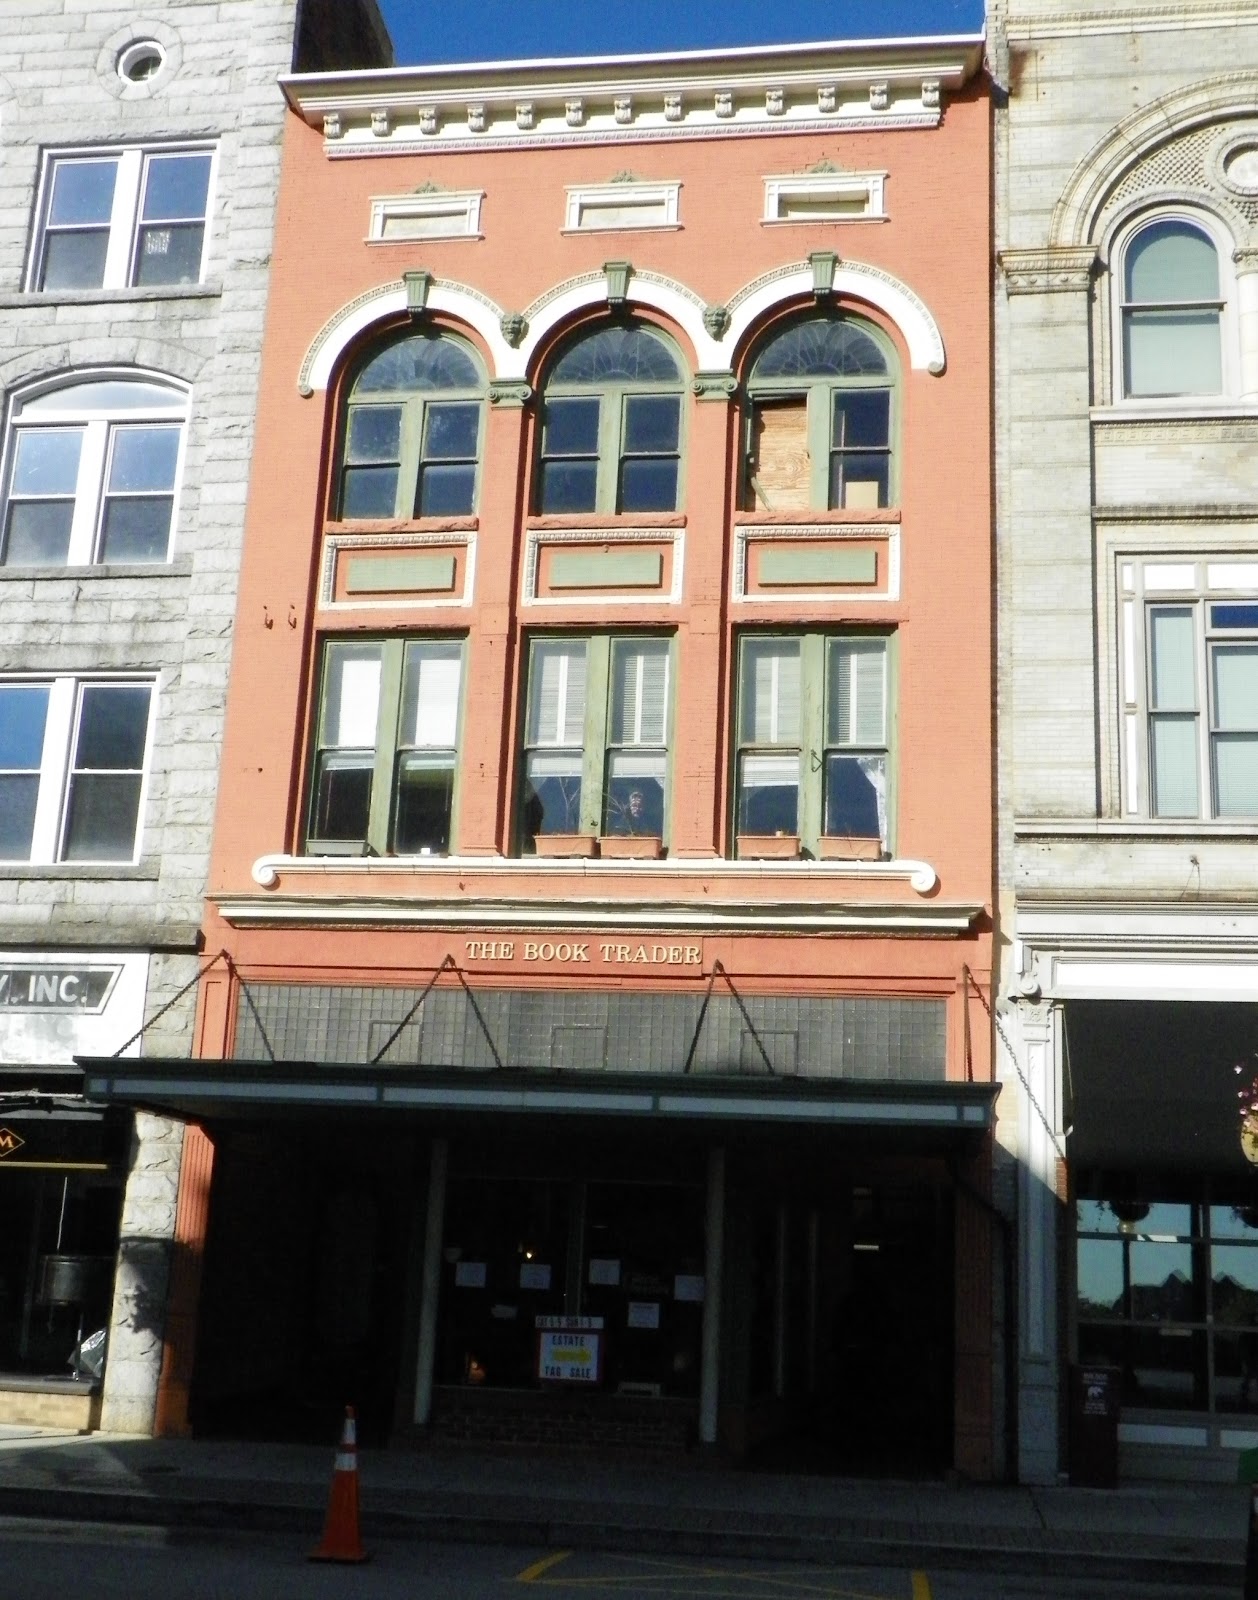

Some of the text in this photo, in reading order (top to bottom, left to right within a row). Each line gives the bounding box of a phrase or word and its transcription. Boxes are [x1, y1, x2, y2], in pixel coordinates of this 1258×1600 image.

[465, 941, 702, 965] THE BOOK TRADER
[28, 974, 87, 1003] INC.
[552, 1335, 585, 1346] ESTATE
[545, 1366, 591, 1379] TAG SALE
